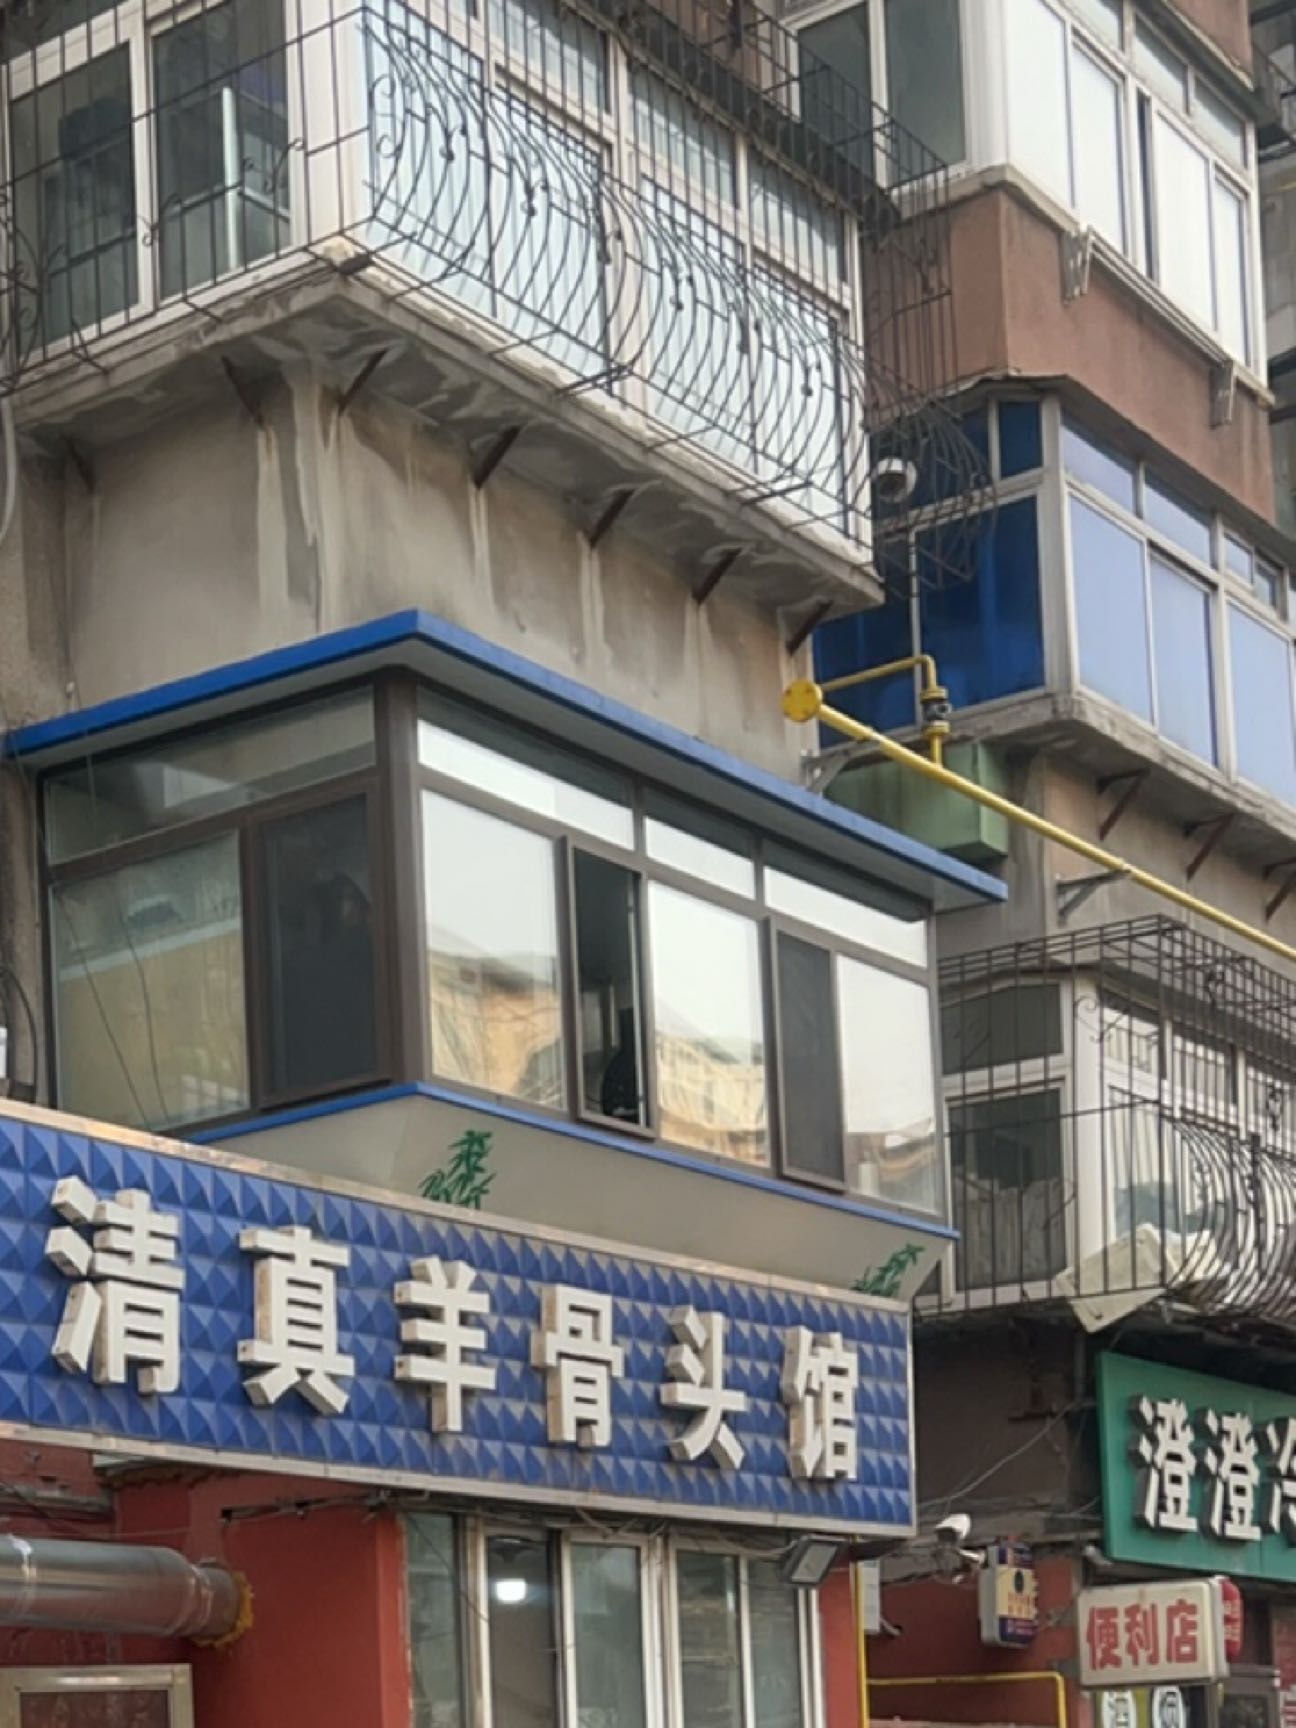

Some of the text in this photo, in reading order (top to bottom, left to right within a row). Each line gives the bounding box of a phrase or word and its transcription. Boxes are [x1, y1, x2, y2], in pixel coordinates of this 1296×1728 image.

[45, 1174, 859, 1482] 清真羊骨头馆
[1086, 1598, 1199, 1671] 便利店
